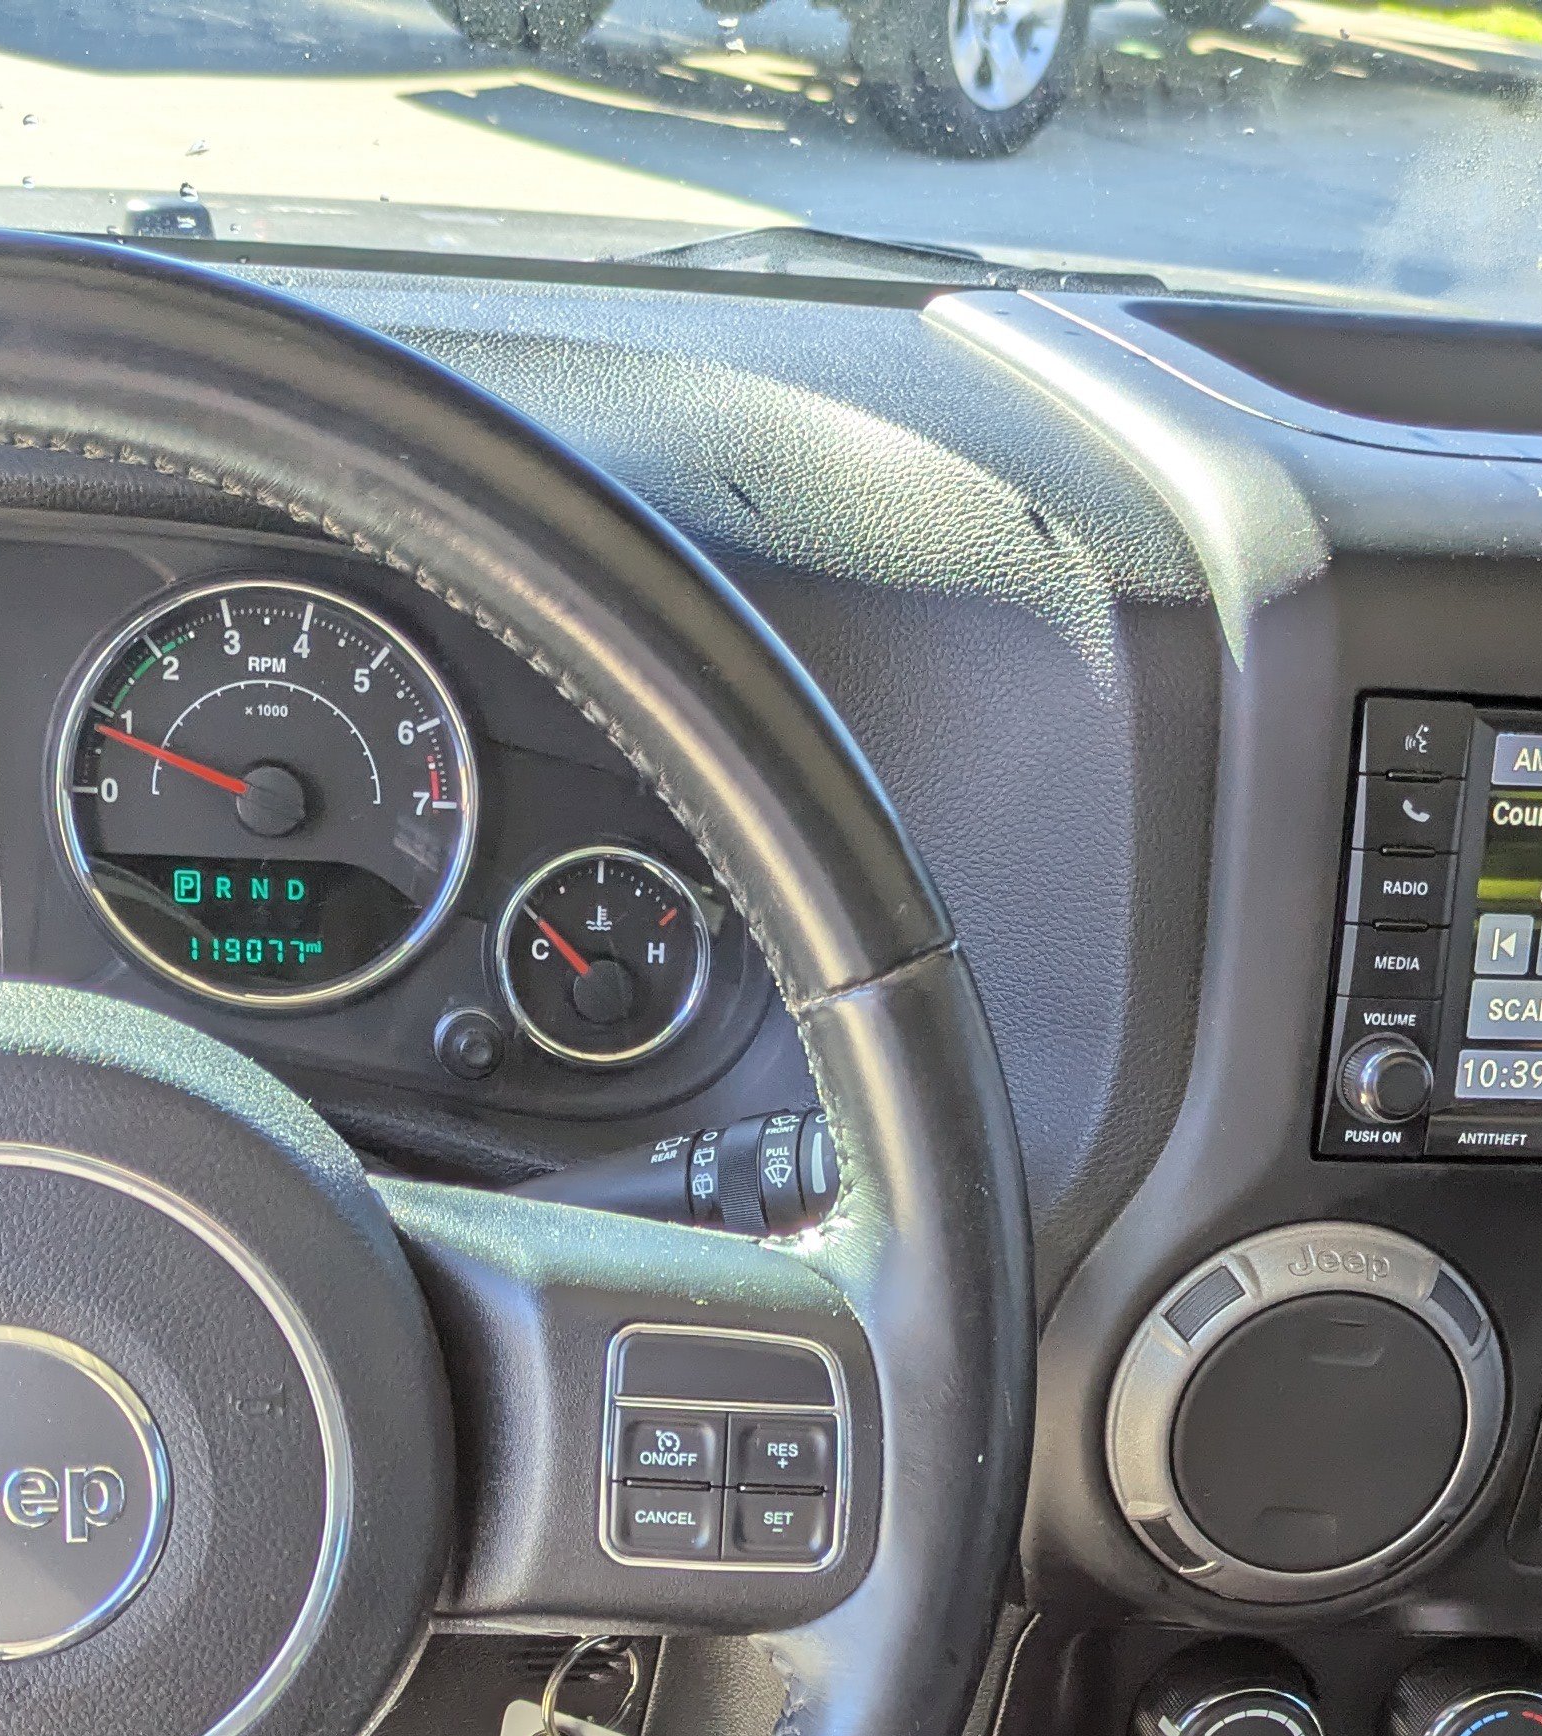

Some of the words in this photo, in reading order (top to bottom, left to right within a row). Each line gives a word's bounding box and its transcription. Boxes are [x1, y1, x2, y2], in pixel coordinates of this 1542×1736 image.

[224, 631, 241, 655] 3
[293, 634, 310, 659] 4
[163, 656, 180, 681] 2
[248, 656, 286, 673] RPM
[354, 668, 371, 693] 5
[257, 704, 288, 718] 1000
[120, 710, 134, 734] 1
[398, 719, 414, 745] 6
[100, 777, 118, 802] 0
[412, 792, 430, 815] 7
[216, 877, 231, 898] R
[251, 878, 268, 899] N
[287, 879, 305, 900] D
[1382, 880, 1429, 896] RADIO
[531, 938, 550, 960] C
[647, 942, 665, 964] H
[1374, 956, 1420, 971] MEDIA
[1363, 1012, 1417, 1027] VOLUME
[1345, 1130, 1379, 1143] PUSH
[1382, 1131, 1402, 1144] ON
[1458, 1132, 1528, 1147] ANTITHEFT
[650, 1150, 678, 1164] REAR
[766, 1146, 790, 1158] PULL
[1287, 1244, 1391, 1282] Jeep
[639, 1451, 698, 1467] ON/OFF
[767, 1443, 799, 1458] RES
[634, 1510, 696, 1526] CANCEL
[763, 1511, 794, 1525] SET
